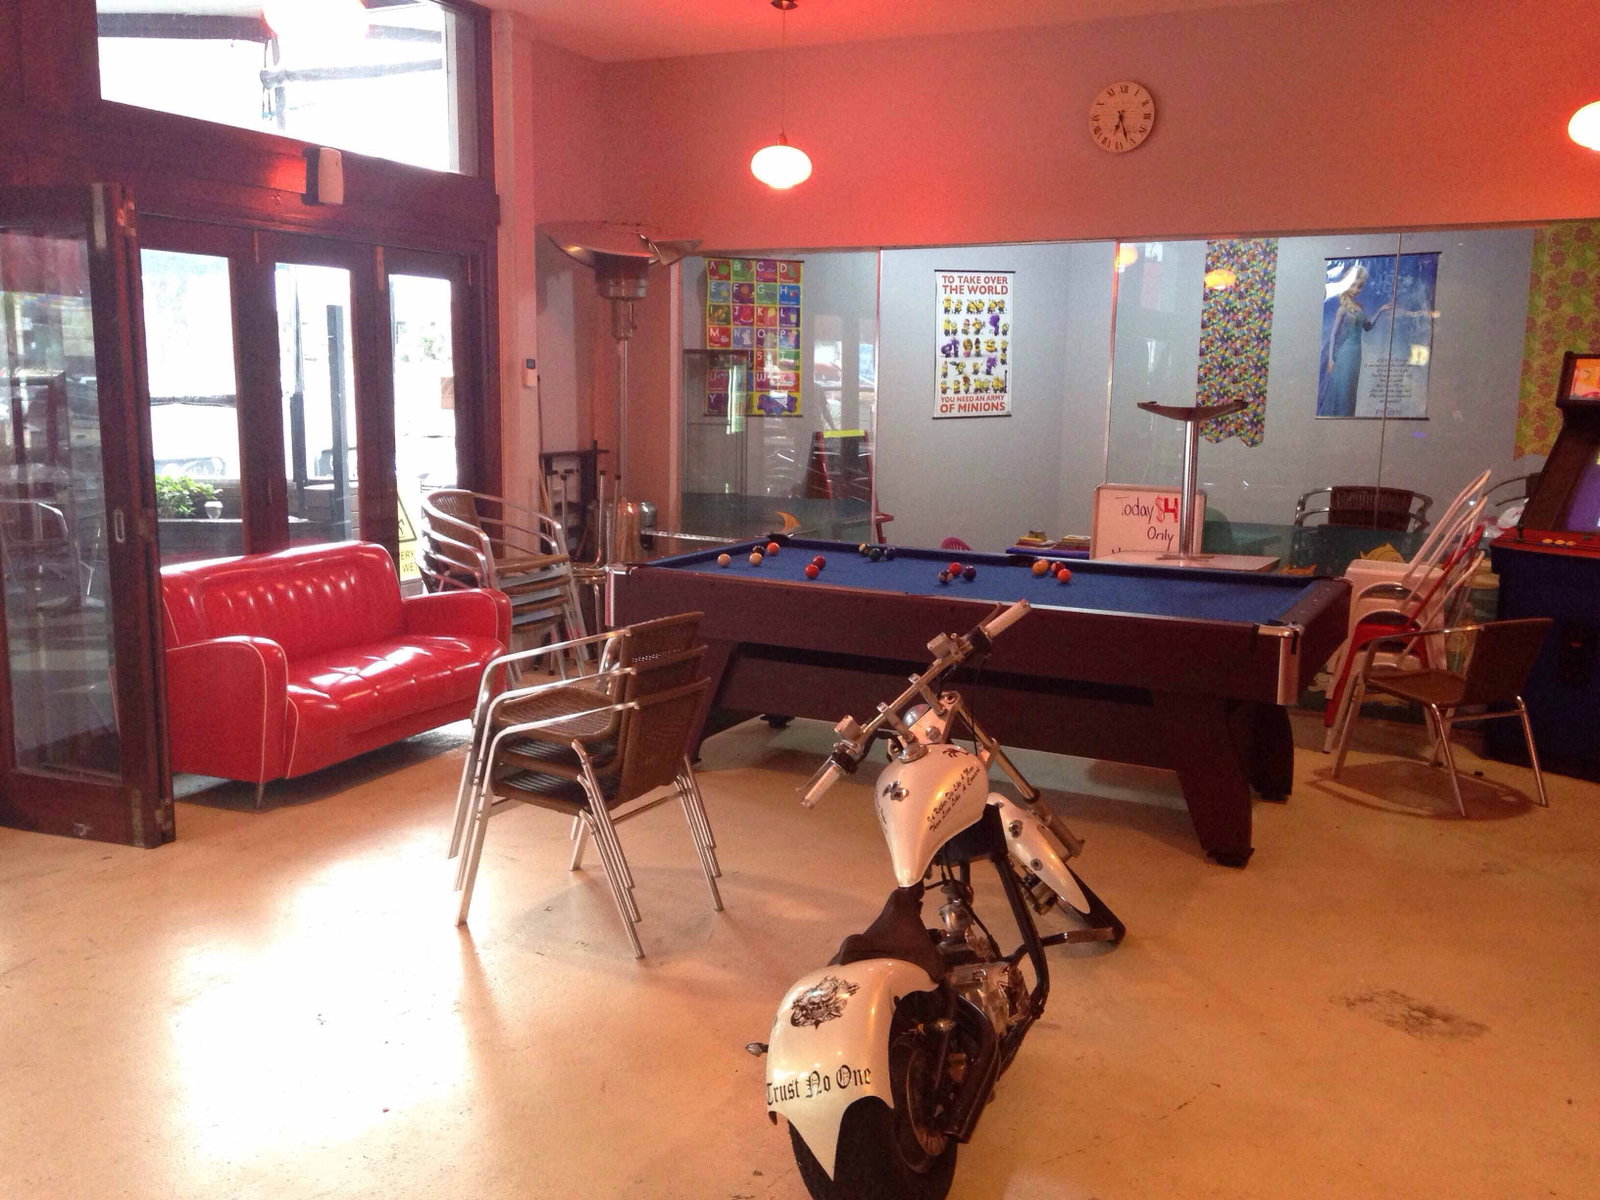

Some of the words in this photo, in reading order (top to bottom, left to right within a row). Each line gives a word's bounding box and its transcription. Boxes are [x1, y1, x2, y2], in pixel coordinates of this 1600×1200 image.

[710, 262, 717, 270] A
[757, 262, 764, 271] C
[780, 263, 787, 273] D
[941, 275, 955, 284] TO
[957, 275, 982, 284] TAKE
[983, 276, 1008, 285] OVER
[711, 283, 716, 292] E
[733, 283, 739, 292] F
[757, 284, 765, 294] G
[779, 286, 788, 295] H
[942, 285, 965, 295] THE
[967, 285, 1009, 295] WORLD
[733, 306, 740, 315] J
[757, 307, 763, 316] K
[780, 308, 785, 317] L
[709, 327, 720, 337] M
[757, 329, 766, 338] O
[780, 329, 786, 338] P
[757, 351, 763, 361] S
[756, 373, 767, 382] W
[709, 394, 716, 403] Y
[940, 404, 955, 413] OF
[958, 402, 1006, 413] MINIONS
[1155, 495, 1179, 523] $4
[1147, 526, 1175, 552] Only
[766, 1079, 801, 1106] Trust
[805, 1070, 831, 1099] No
[836, 1064, 872, 1089] One
